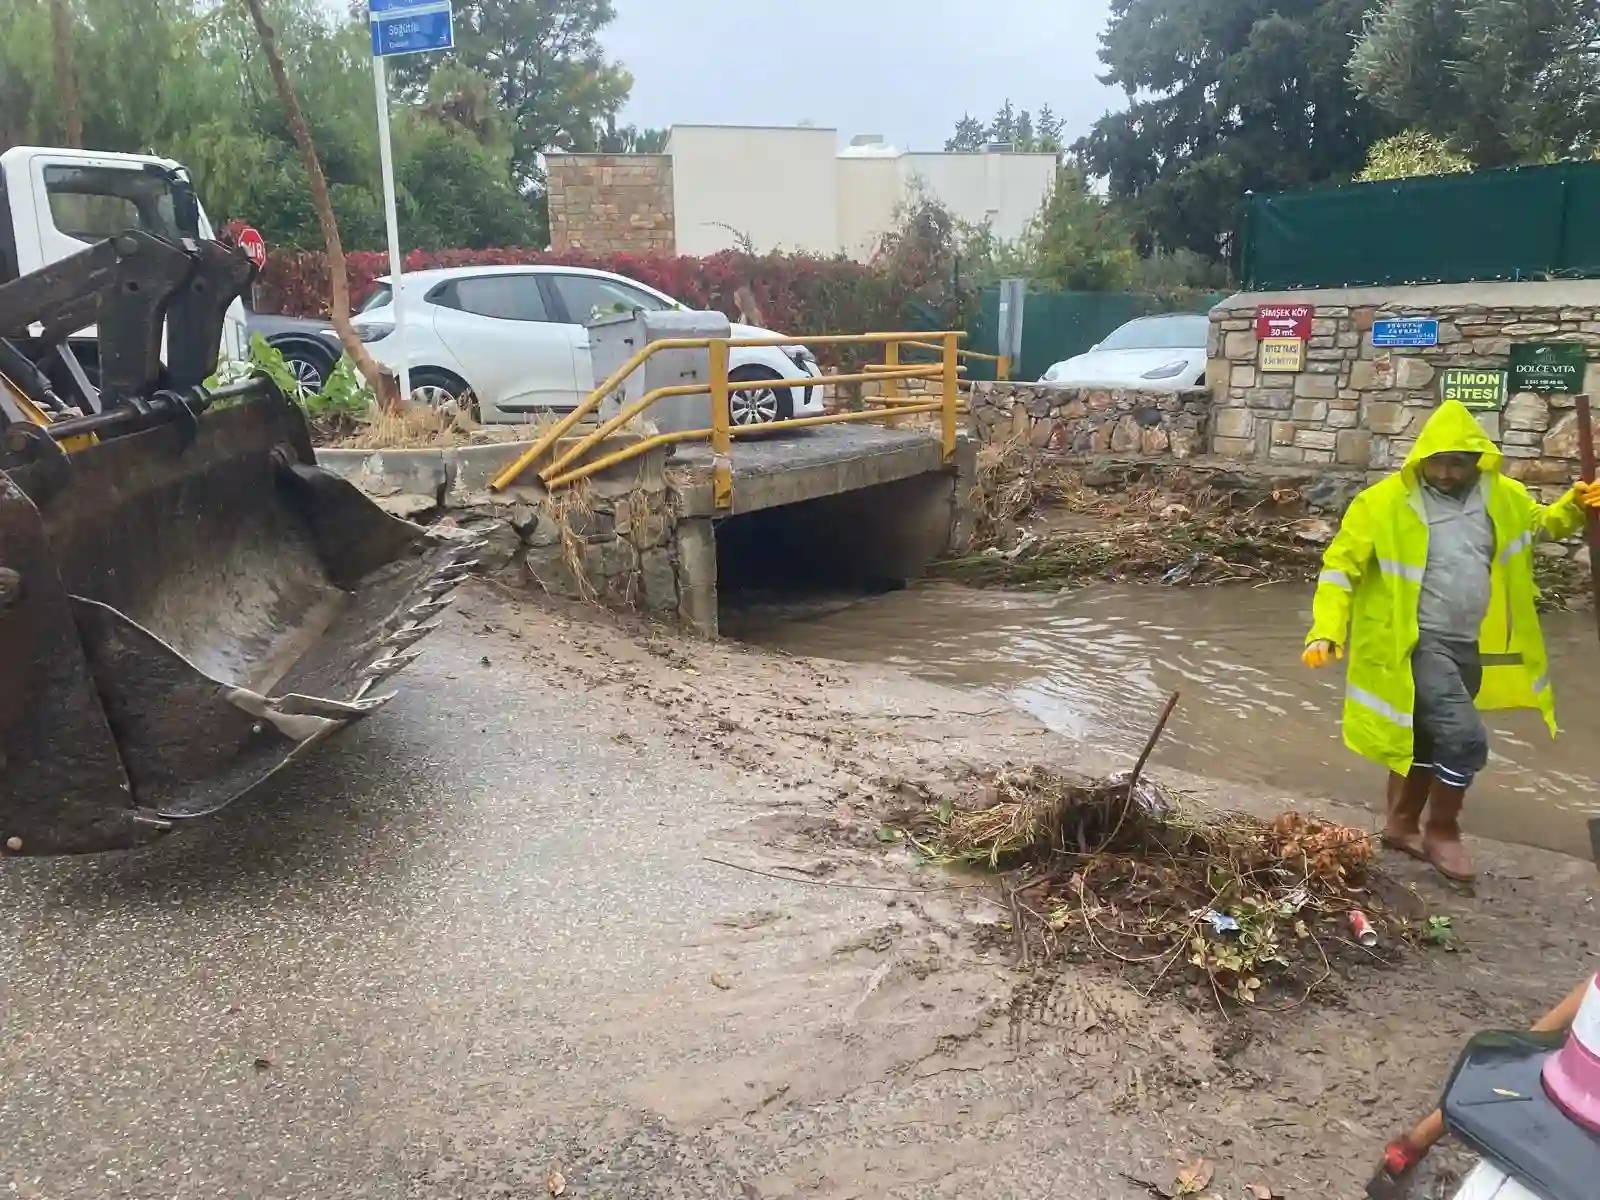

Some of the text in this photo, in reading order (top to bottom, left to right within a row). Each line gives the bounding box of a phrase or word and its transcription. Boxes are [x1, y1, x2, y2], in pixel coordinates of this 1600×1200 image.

[1261, 307, 1308, 318] ŞİMŞEK KÖY
[1270, 328, 1280, 336] 30
[1516, 365, 1576, 373] DOLCE VITA
[1445, 385, 1499, 400] SİTESİ
